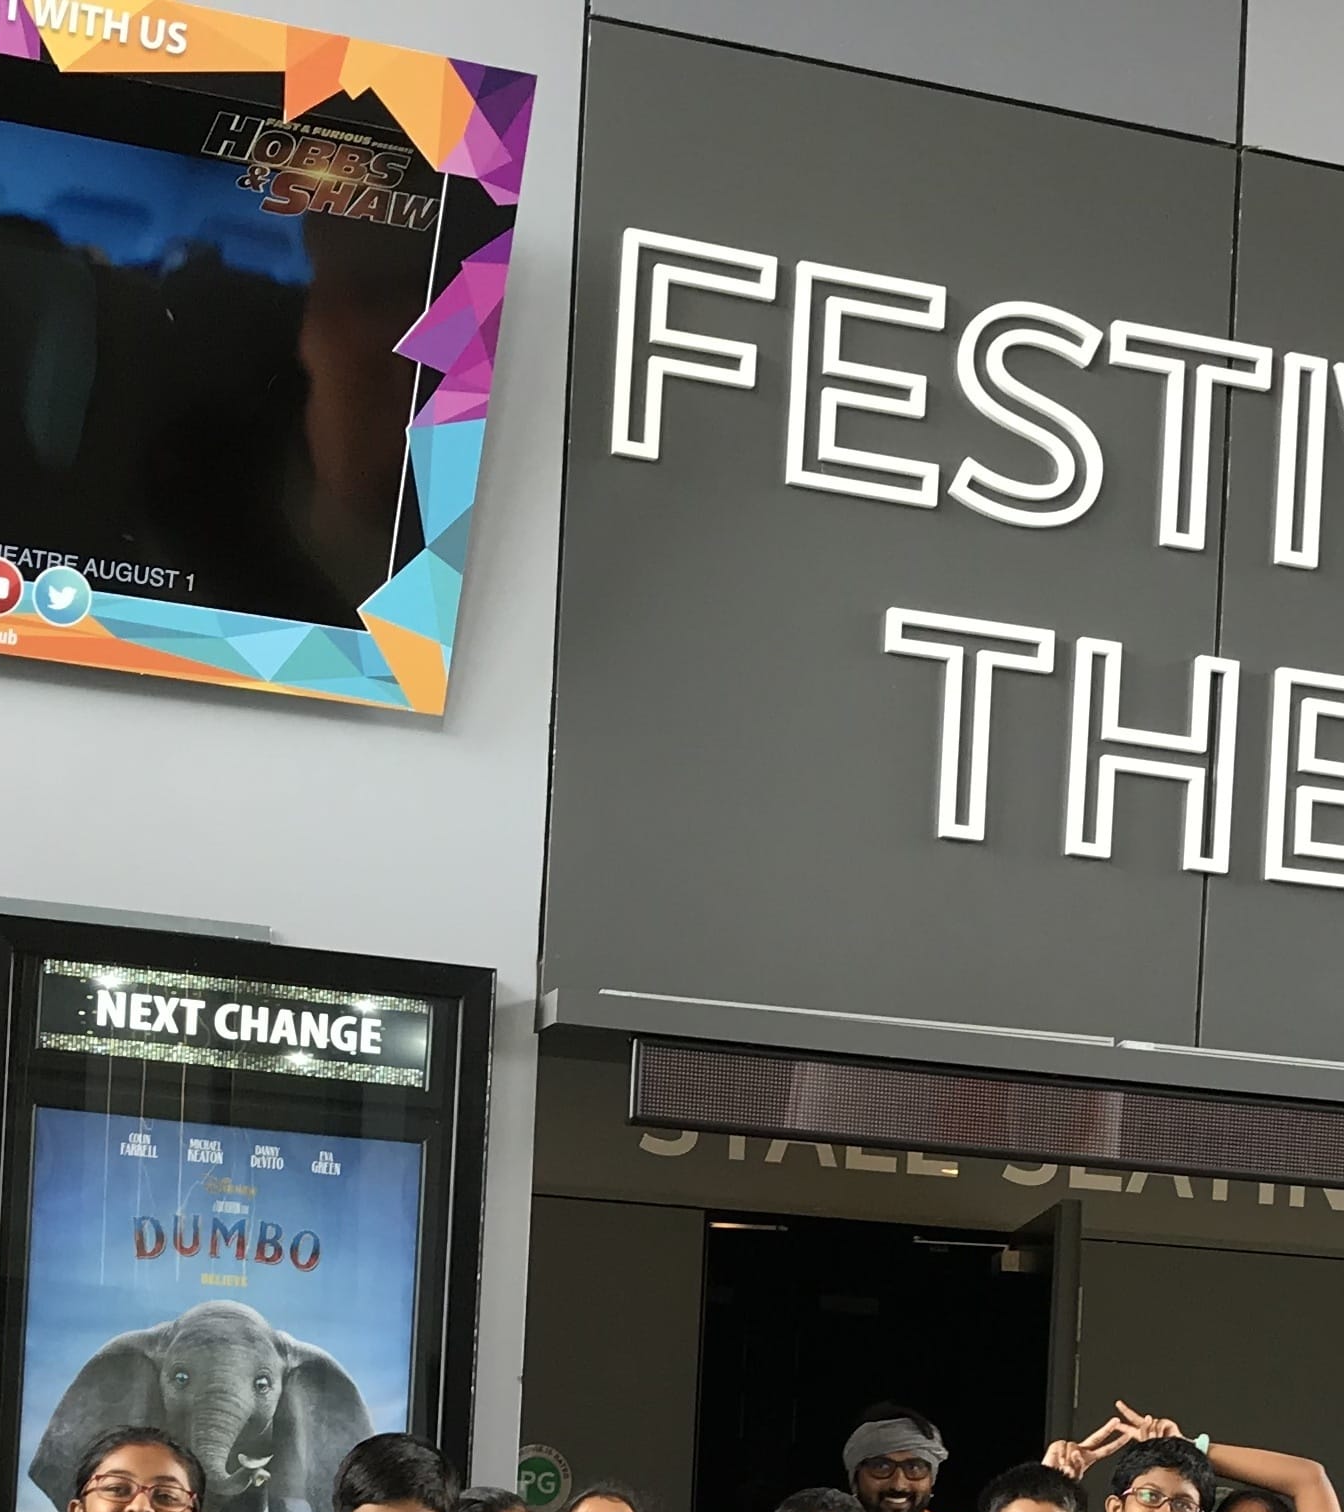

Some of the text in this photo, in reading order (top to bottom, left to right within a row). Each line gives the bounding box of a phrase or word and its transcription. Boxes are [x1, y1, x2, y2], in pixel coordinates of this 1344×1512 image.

[35, 0, 131, 43] WITH
[139, 14, 189, 54] US
[312, 127, 373, 145] FURIOUS
[201, 111, 411, 189] HOBBS
[236, 164, 442, 232] & SHAW
[82, 558, 180, 589] AUGUST
[185, 573, 196, 592] 1
[96, 989, 382, 1055] NEXT CHANGE
[128, 1132, 151, 1145] COLIN
[189, 1138, 221, 1152] MICHAEL
[120, 1142, 158, 1159] FARRELL
[187, 1149, 224, 1165] KEATON
[254, 1144, 281, 1157] DANNY
[319, 1150, 334, 1162] EVA
[311, 1160, 342, 1176] GREEN
[133, 1214, 321, 1273] DUMBO
[520, 1470, 556, 1495] PG
